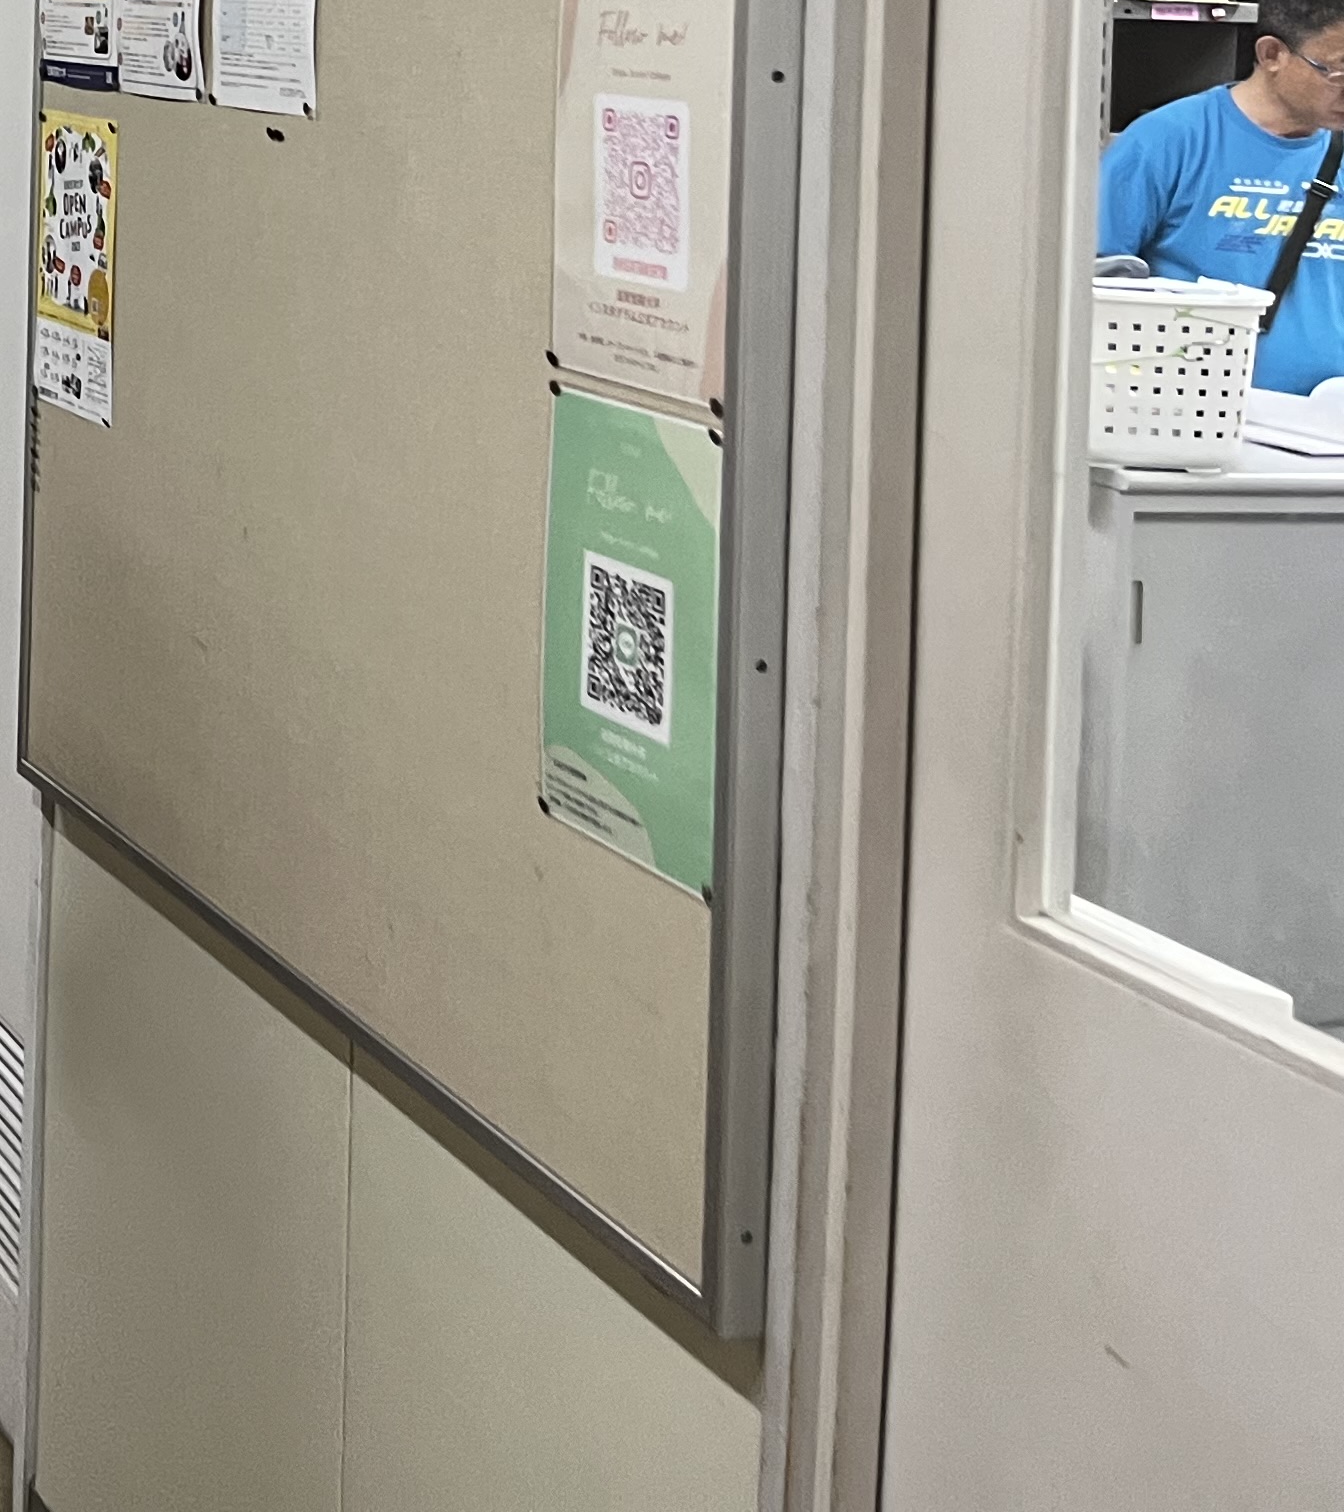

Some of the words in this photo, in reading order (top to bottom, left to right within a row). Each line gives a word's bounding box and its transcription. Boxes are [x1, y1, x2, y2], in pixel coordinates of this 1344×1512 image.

[63, 193, 87, 216] OPEN
[1208, 195, 1271, 220] ALL
[60, 215, 92, 239] CAMPUS
[1254, 214, 1344, 242] JAA
